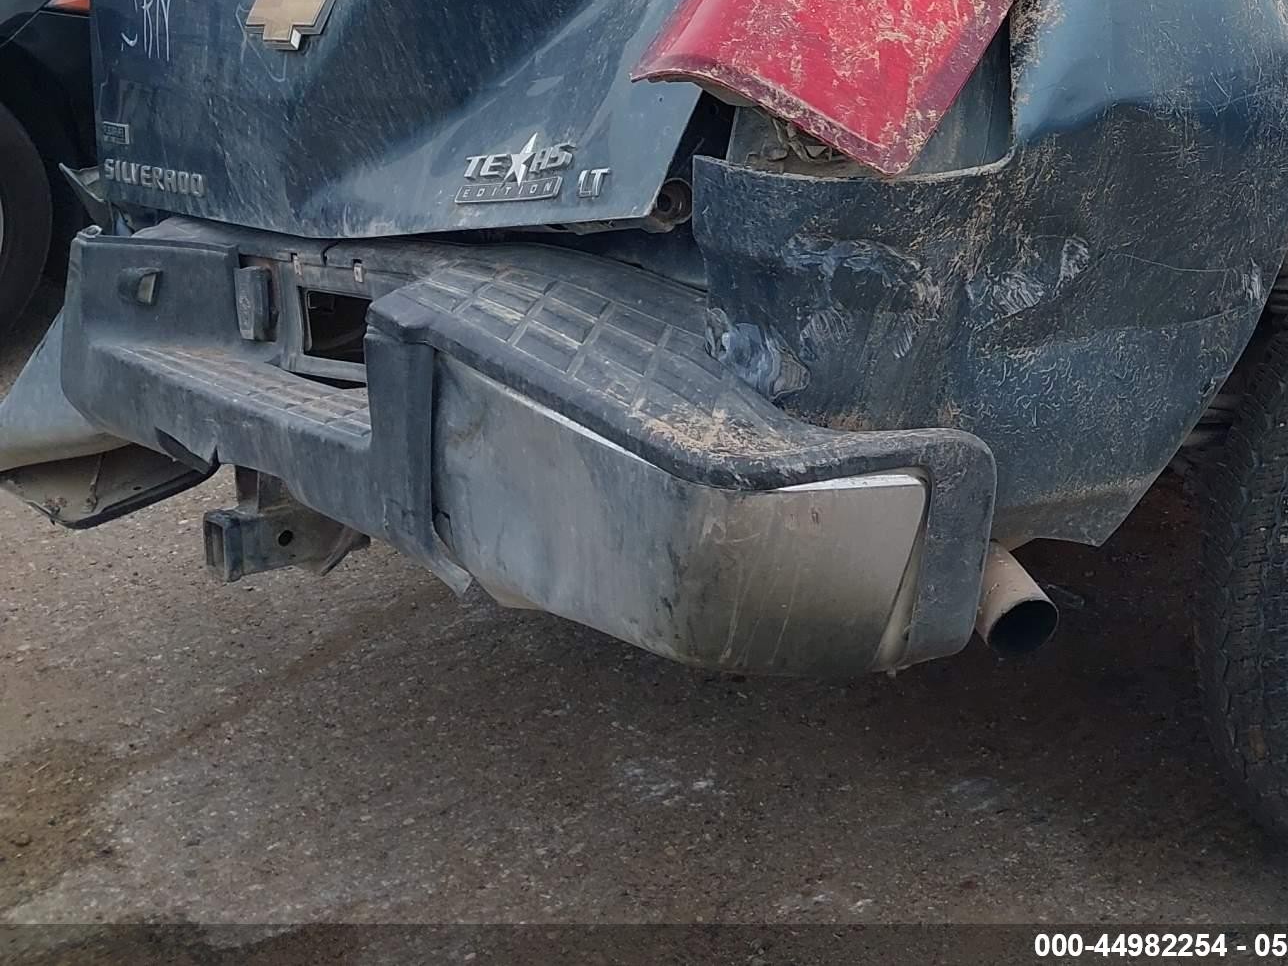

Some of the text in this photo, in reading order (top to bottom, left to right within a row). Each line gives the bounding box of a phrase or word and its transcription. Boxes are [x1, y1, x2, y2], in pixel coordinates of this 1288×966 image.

[464, 133, 573, 185] TEXAS
[104, 158, 204, 196] SILVERADO
[462, 181, 554, 198] EDITION
[577, 167, 611, 199] LT
